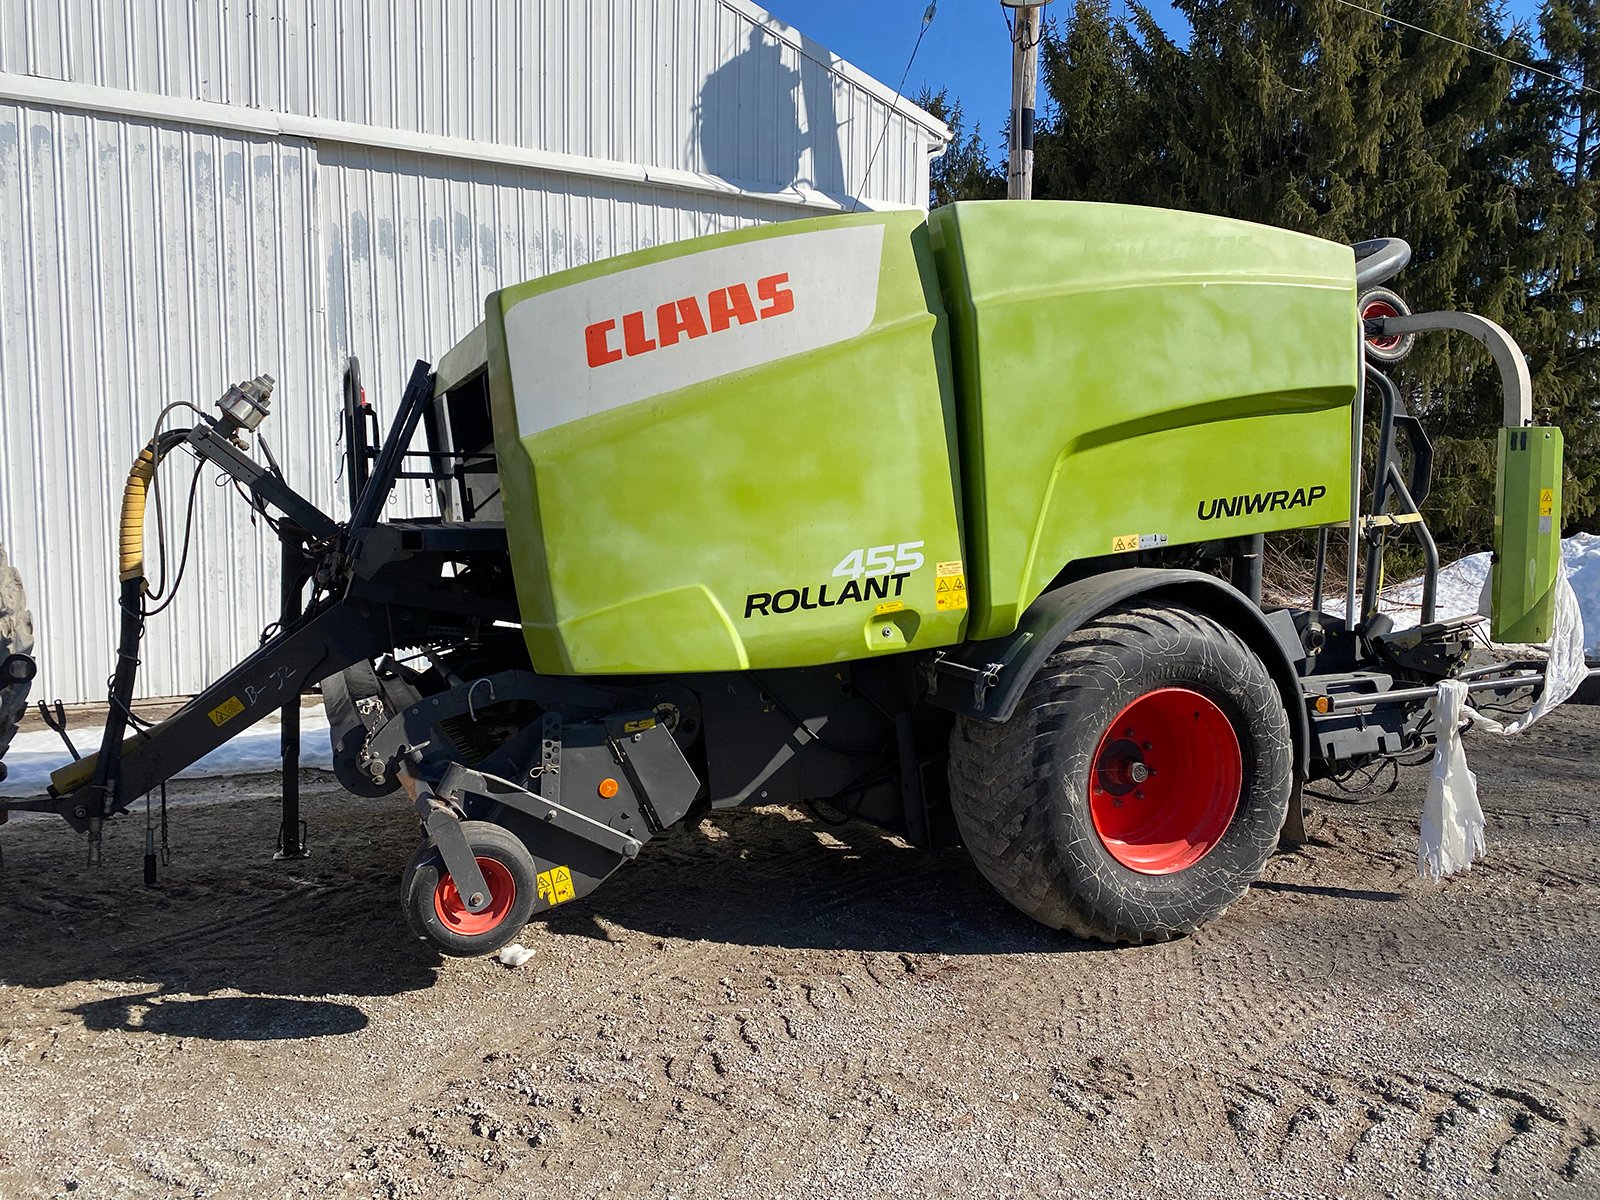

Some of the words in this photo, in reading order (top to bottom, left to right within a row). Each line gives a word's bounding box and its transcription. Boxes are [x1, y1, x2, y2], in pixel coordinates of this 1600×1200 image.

[585, 272, 795, 368] CLAAS
[1197, 485, 1327, 520] UNIWRAP
[832, 540, 925, 579] 455
[744, 572, 911, 618] ROLLANT
